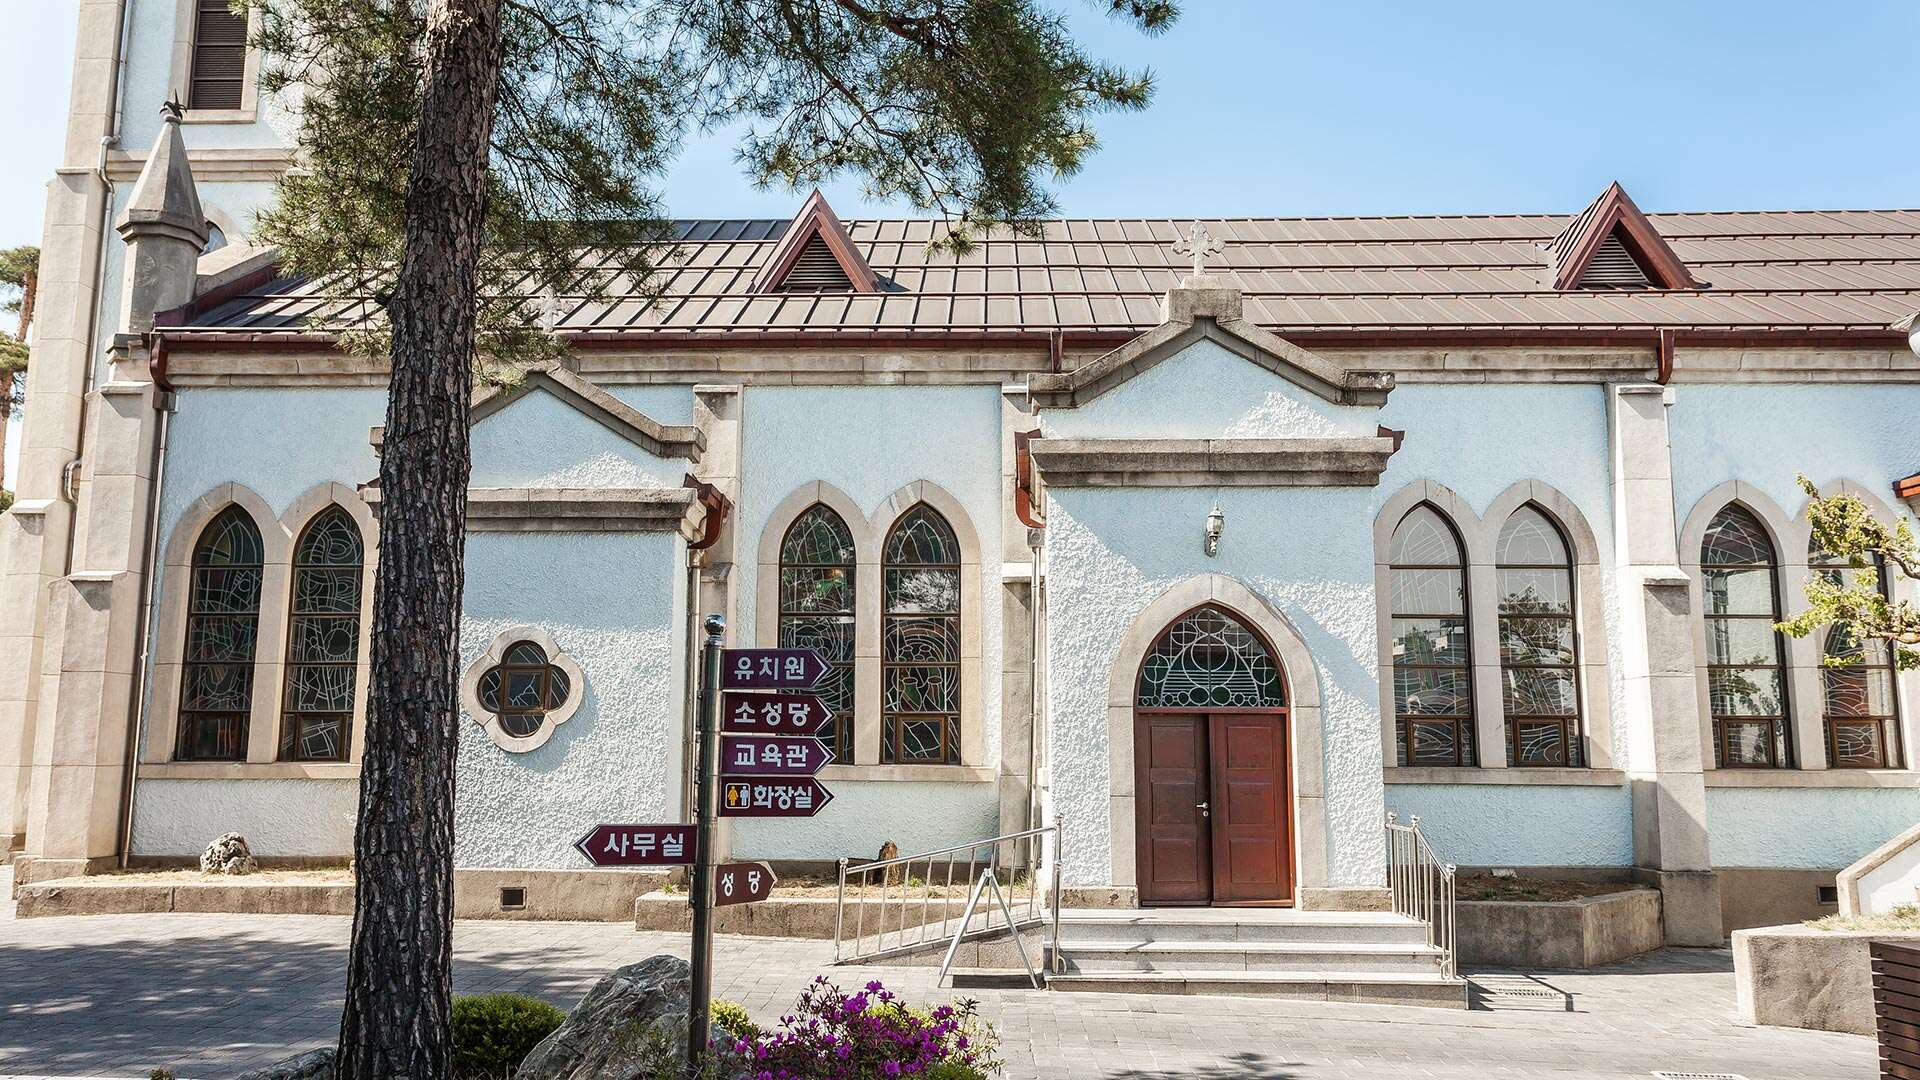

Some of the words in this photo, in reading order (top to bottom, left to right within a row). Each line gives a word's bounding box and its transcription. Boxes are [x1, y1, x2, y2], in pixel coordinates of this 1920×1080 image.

[734, 656, 805, 681] 유치원
[734, 702, 811, 727] 소성당
[734, 743, 809, 769] 교육관
[753, 785, 813, 810] 화장실
[603, 833, 684, 858] 사무실
